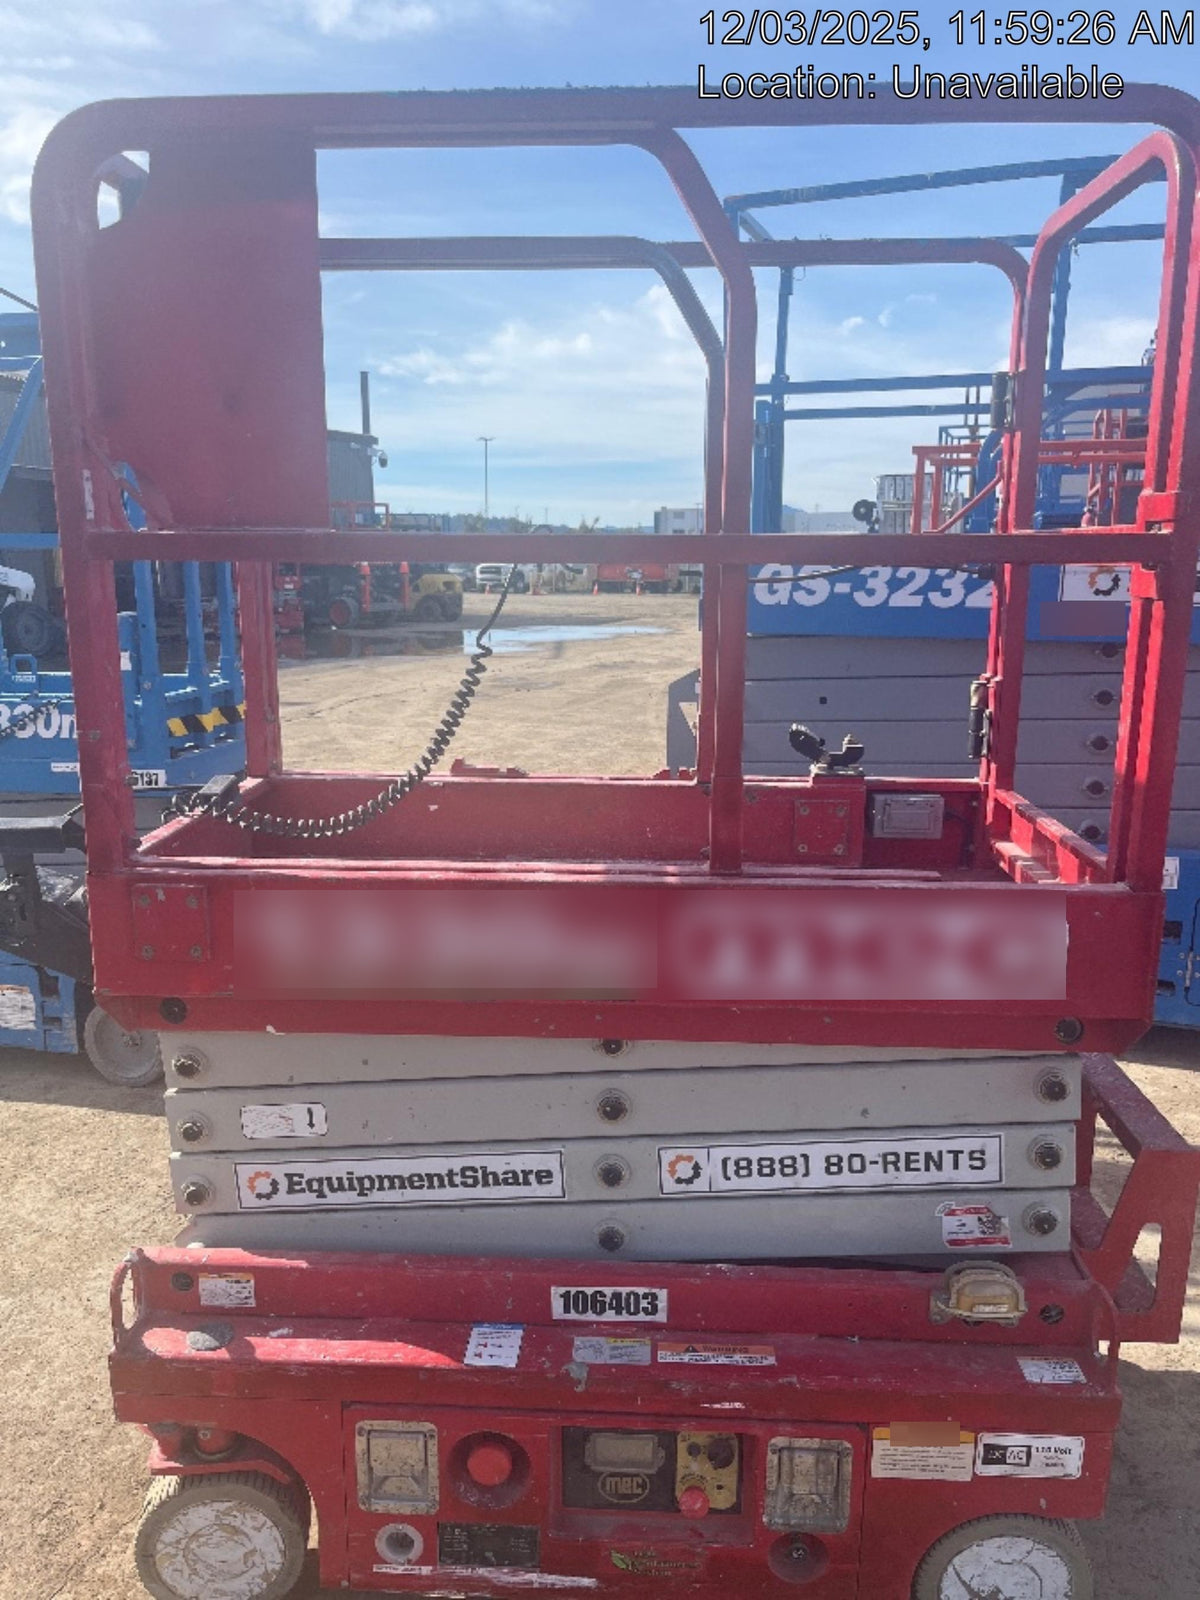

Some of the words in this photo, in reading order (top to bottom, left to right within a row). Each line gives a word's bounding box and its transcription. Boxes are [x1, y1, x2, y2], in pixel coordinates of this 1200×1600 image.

[721, 1153, 810, 1181] (888)
[824, 1149, 987, 1177] 80-RENTS
[284, 1165, 554, 1198] EquipmentShare
[560, 1290, 659, 1316] 106403
